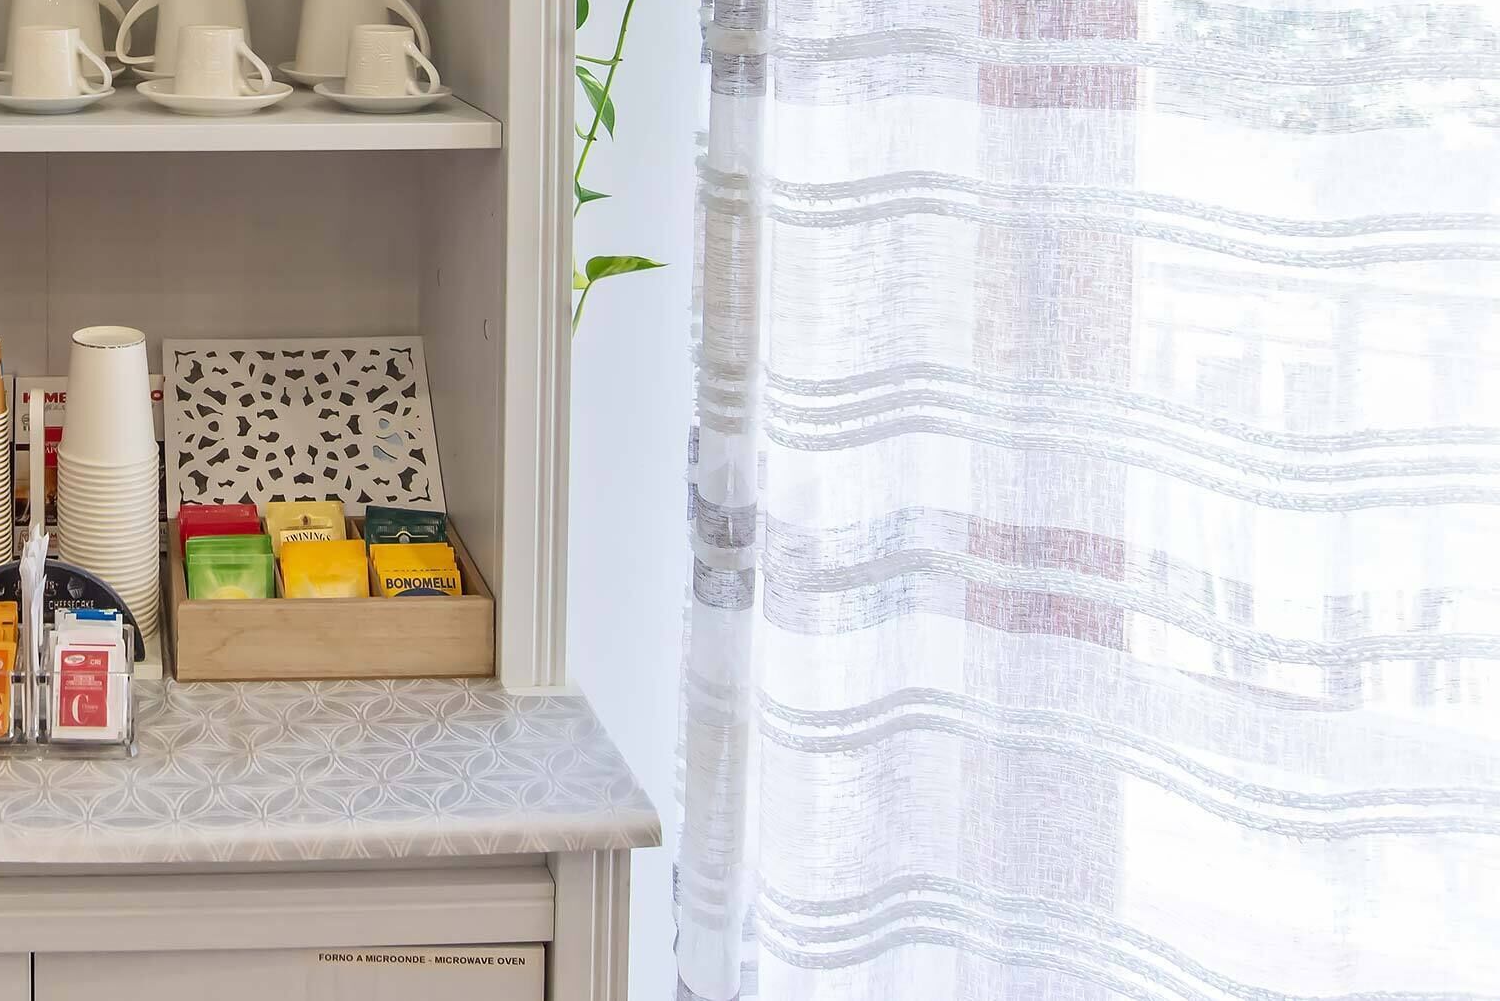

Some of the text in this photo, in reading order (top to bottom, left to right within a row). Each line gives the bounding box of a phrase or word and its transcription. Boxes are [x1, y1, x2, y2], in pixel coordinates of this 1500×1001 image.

[385, 577, 456, 589] BONOMELLI
[48, 600, 95, 610] CHEESECAKE
[318, 953, 354, 962] FORNO
[356, 954, 363, 962] A
[365, 954, 426, 964] MICROONDE
[434, 956, 494, 965] MICROWAVE
[497, 956, 526, 966] OVEN
